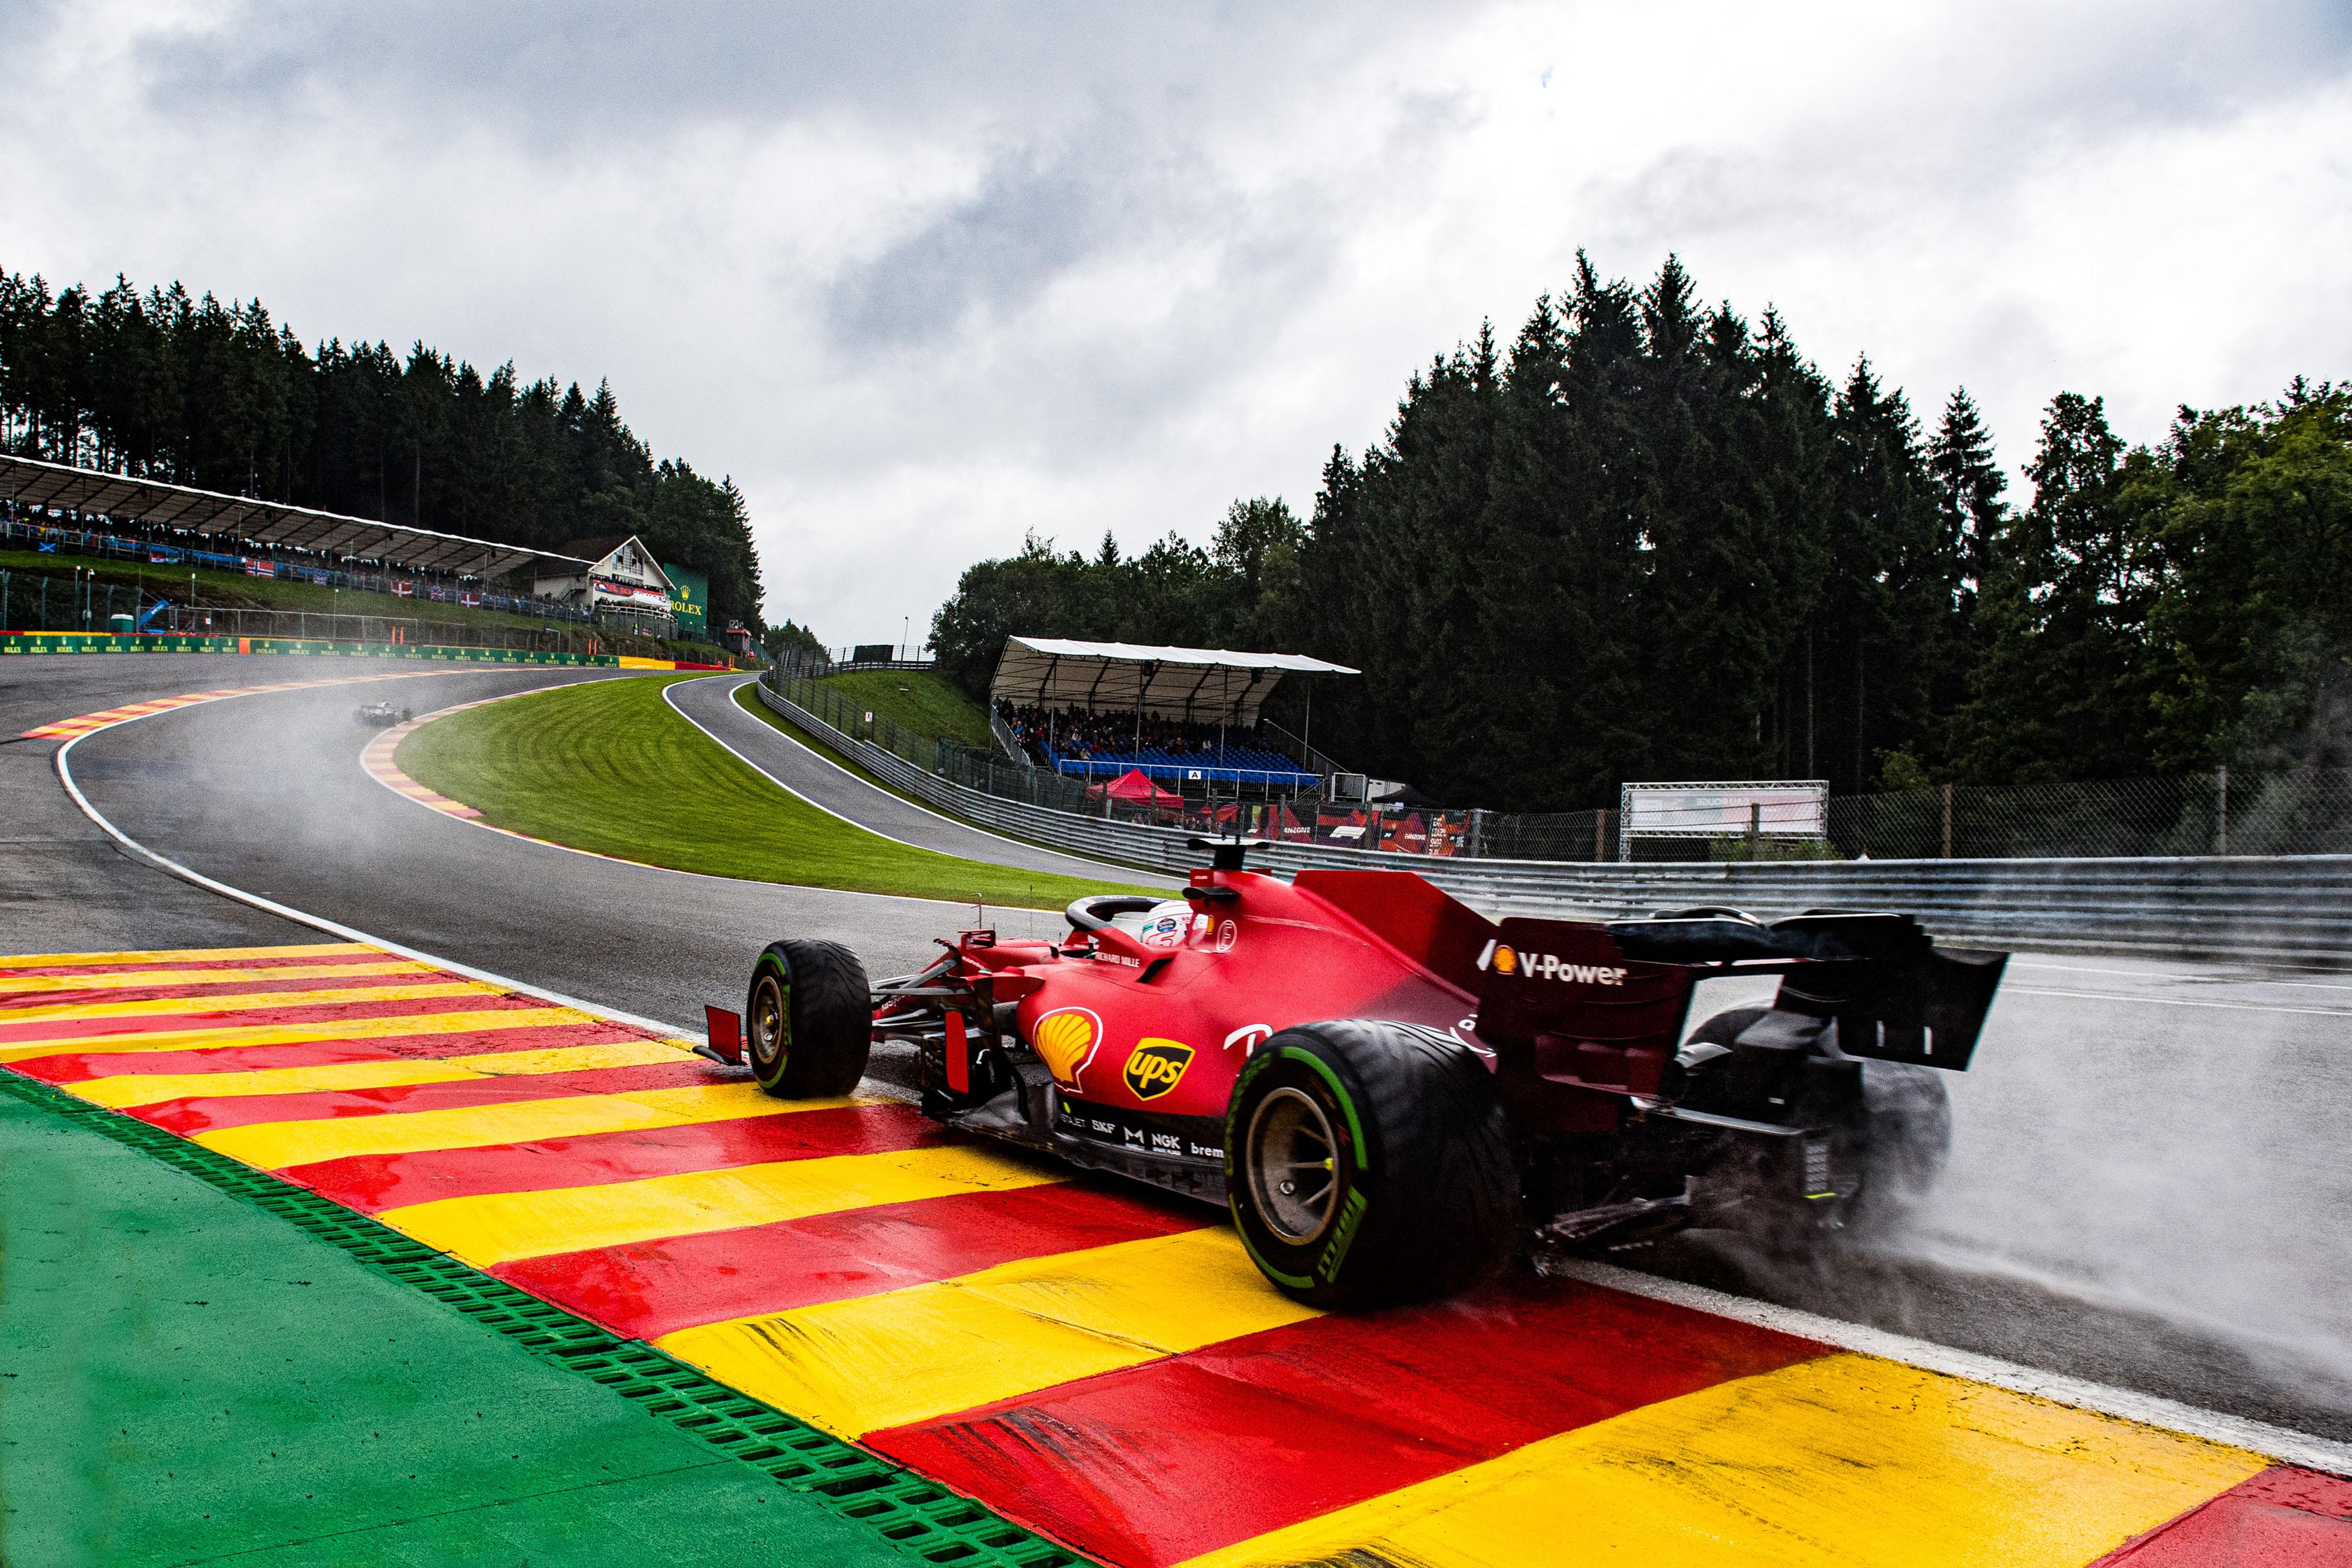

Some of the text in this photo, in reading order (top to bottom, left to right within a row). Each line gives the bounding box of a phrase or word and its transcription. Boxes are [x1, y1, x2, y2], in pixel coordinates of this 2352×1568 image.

[1095, 952, 1140, 968] RICHARD MILLE
[1518, 952, 1628, 986] V-Power
[1128, 1051, 1184, 1089] ups
[1091, 1119, 1115, 1134] SKF
[1151, 1133, 1181, 1149] NGK
[1191, 1142, 1224, 1158] brem
